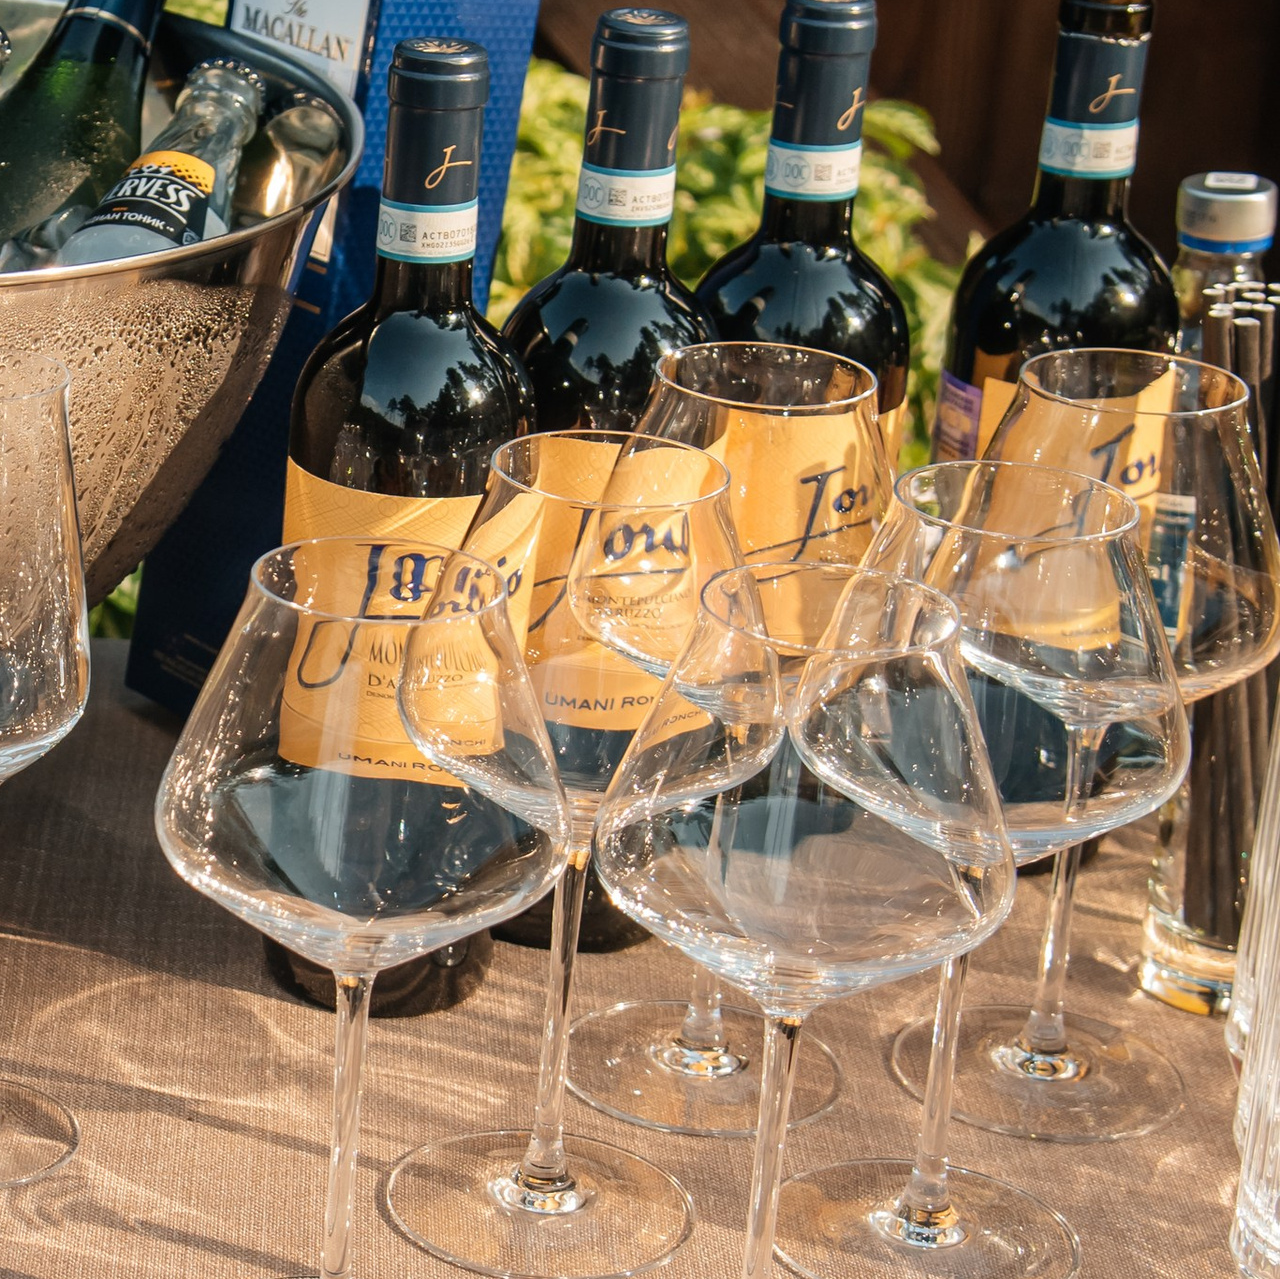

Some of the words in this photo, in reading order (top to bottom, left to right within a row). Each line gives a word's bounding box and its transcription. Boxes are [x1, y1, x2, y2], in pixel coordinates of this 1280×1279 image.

[242, 3, 354, 63] MACALLAN
[784, 162, 808, 181] DOC
[104, 176, 197, 213] ERVESS
[122, 211, 167, 230] ТОНИК
[544, 691, 615, 711] UMANI
[337, 751, 407, 769] UMANI
